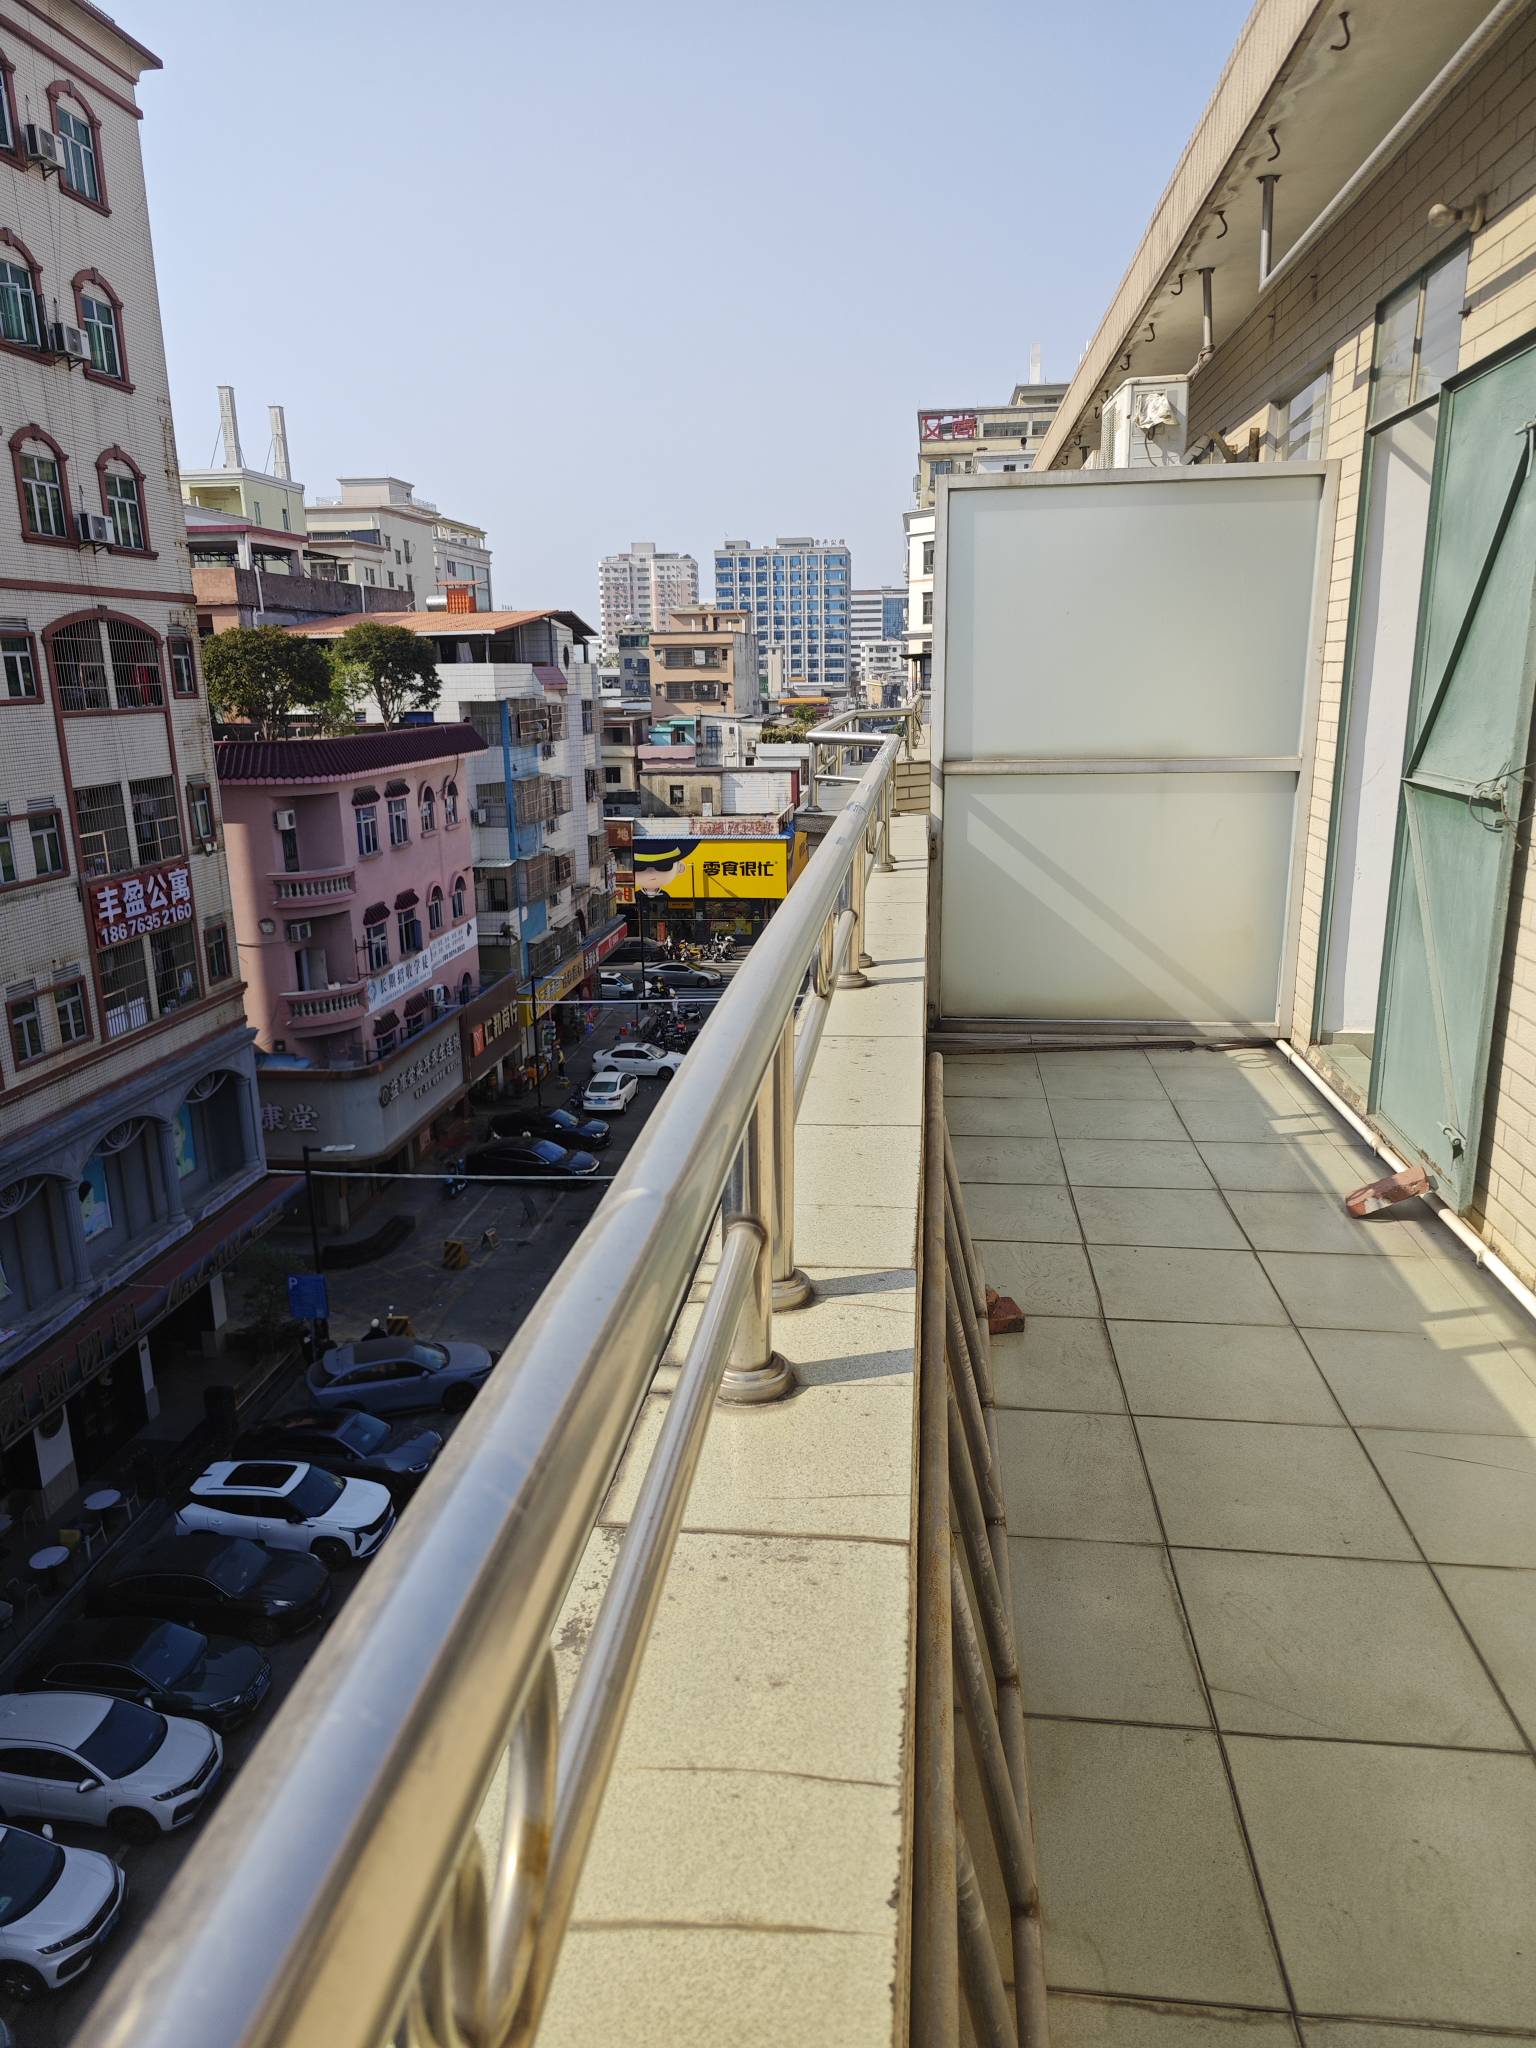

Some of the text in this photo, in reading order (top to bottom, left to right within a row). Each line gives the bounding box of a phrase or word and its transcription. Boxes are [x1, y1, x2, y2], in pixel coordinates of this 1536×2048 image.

[703, 860, 775, 877] 零食很忙
[96, 867, 191, 924] 丰盈公寓
[101, 902, 192, 945] 186 7635 2160
[380, 952, 429, 994] 长期招收学徒
[484, 1000, 519, 1046] 仁和商行
[288, 1276, 298, 1290] P
